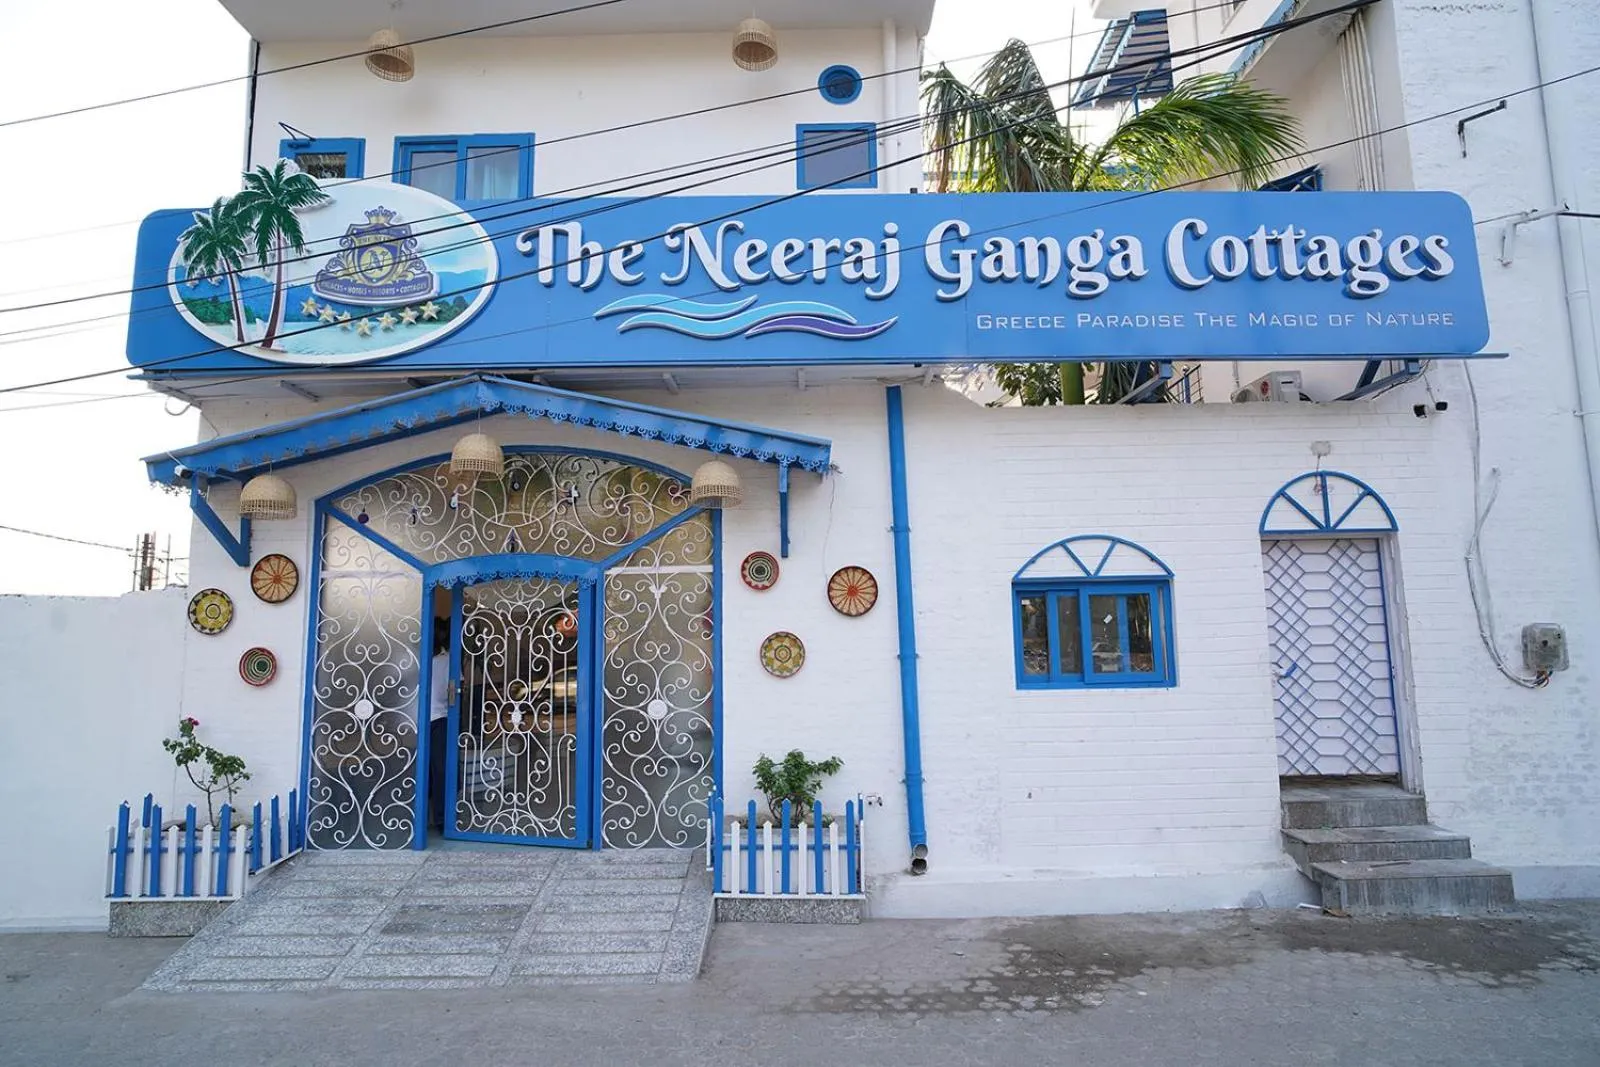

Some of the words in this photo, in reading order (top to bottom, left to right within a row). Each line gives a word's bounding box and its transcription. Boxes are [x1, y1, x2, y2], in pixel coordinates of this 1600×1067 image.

[516, 221, 645, 290] The
[660, 220, 901, 299] Neeraj
[924, 219, 1150, 301] Ganga
[1165, 218, 1455, 298] Cottages
[977, 314, 1066, 329] GREECE
[1077, 313, 1185, 329] PARADISE
[1194, 312, 1237, 327] THE
[1249, 312, 1318, 327] MAGIC
[1367, 312, 1454, 327] NATURE
